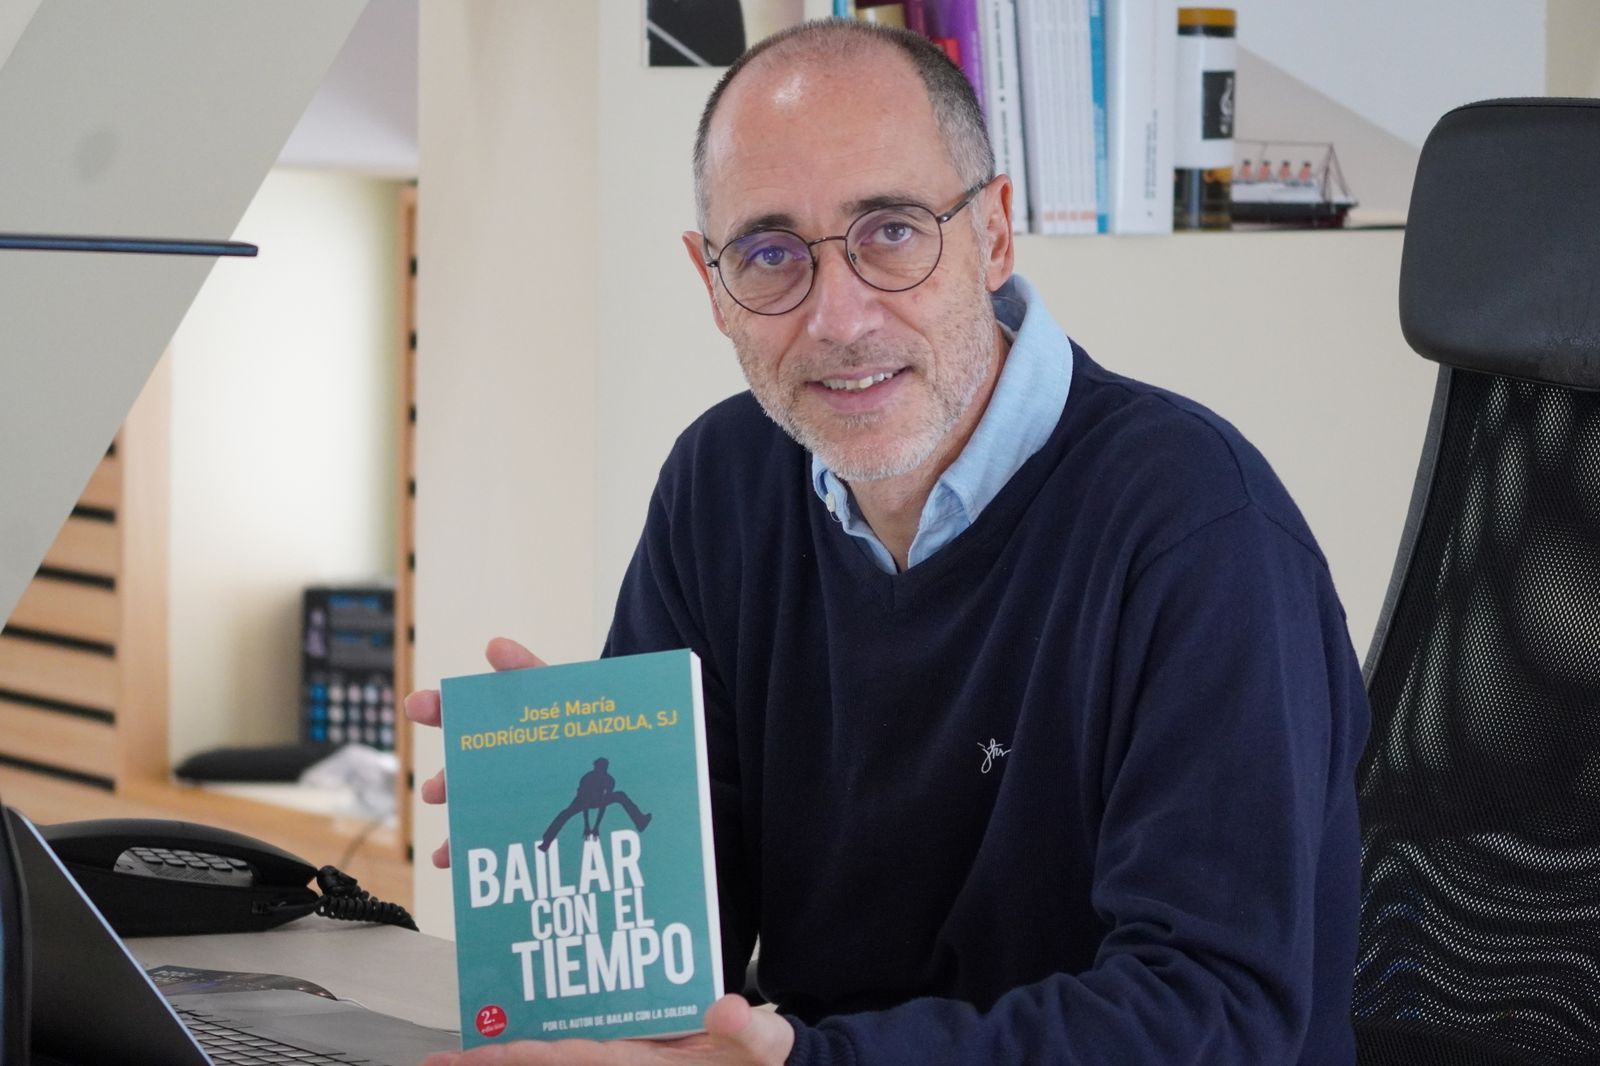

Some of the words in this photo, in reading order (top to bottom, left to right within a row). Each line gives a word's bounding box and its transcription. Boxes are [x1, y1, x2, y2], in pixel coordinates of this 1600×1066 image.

[460, 725, 560, 751] RODRÍGUEZ
[563, 714, 653, 738] OLAIZOLA,
[656, 710, 678, 727] SJ
[519, 703, 560, 723] José
[565, 697, 616, 716] María
[468, 829, 645, 909] BAILAR
[530, 893, 599, 941] CON
[614, 887, 655, 931] EL
[511, 922, 695, 1002] TIEMPO
[542, 1020, 558, 1032] POR
[558, 1019, 569, 1030] EL
[569, 1016, 594, 1029] AUTOR
[606, 1012, 634, 1025] BAILAR
[635, 1010, 651, 1021] CON
[652, 1008, 662, 1019] LA
[664, 1004, 698, 1018] SOLEDAD
